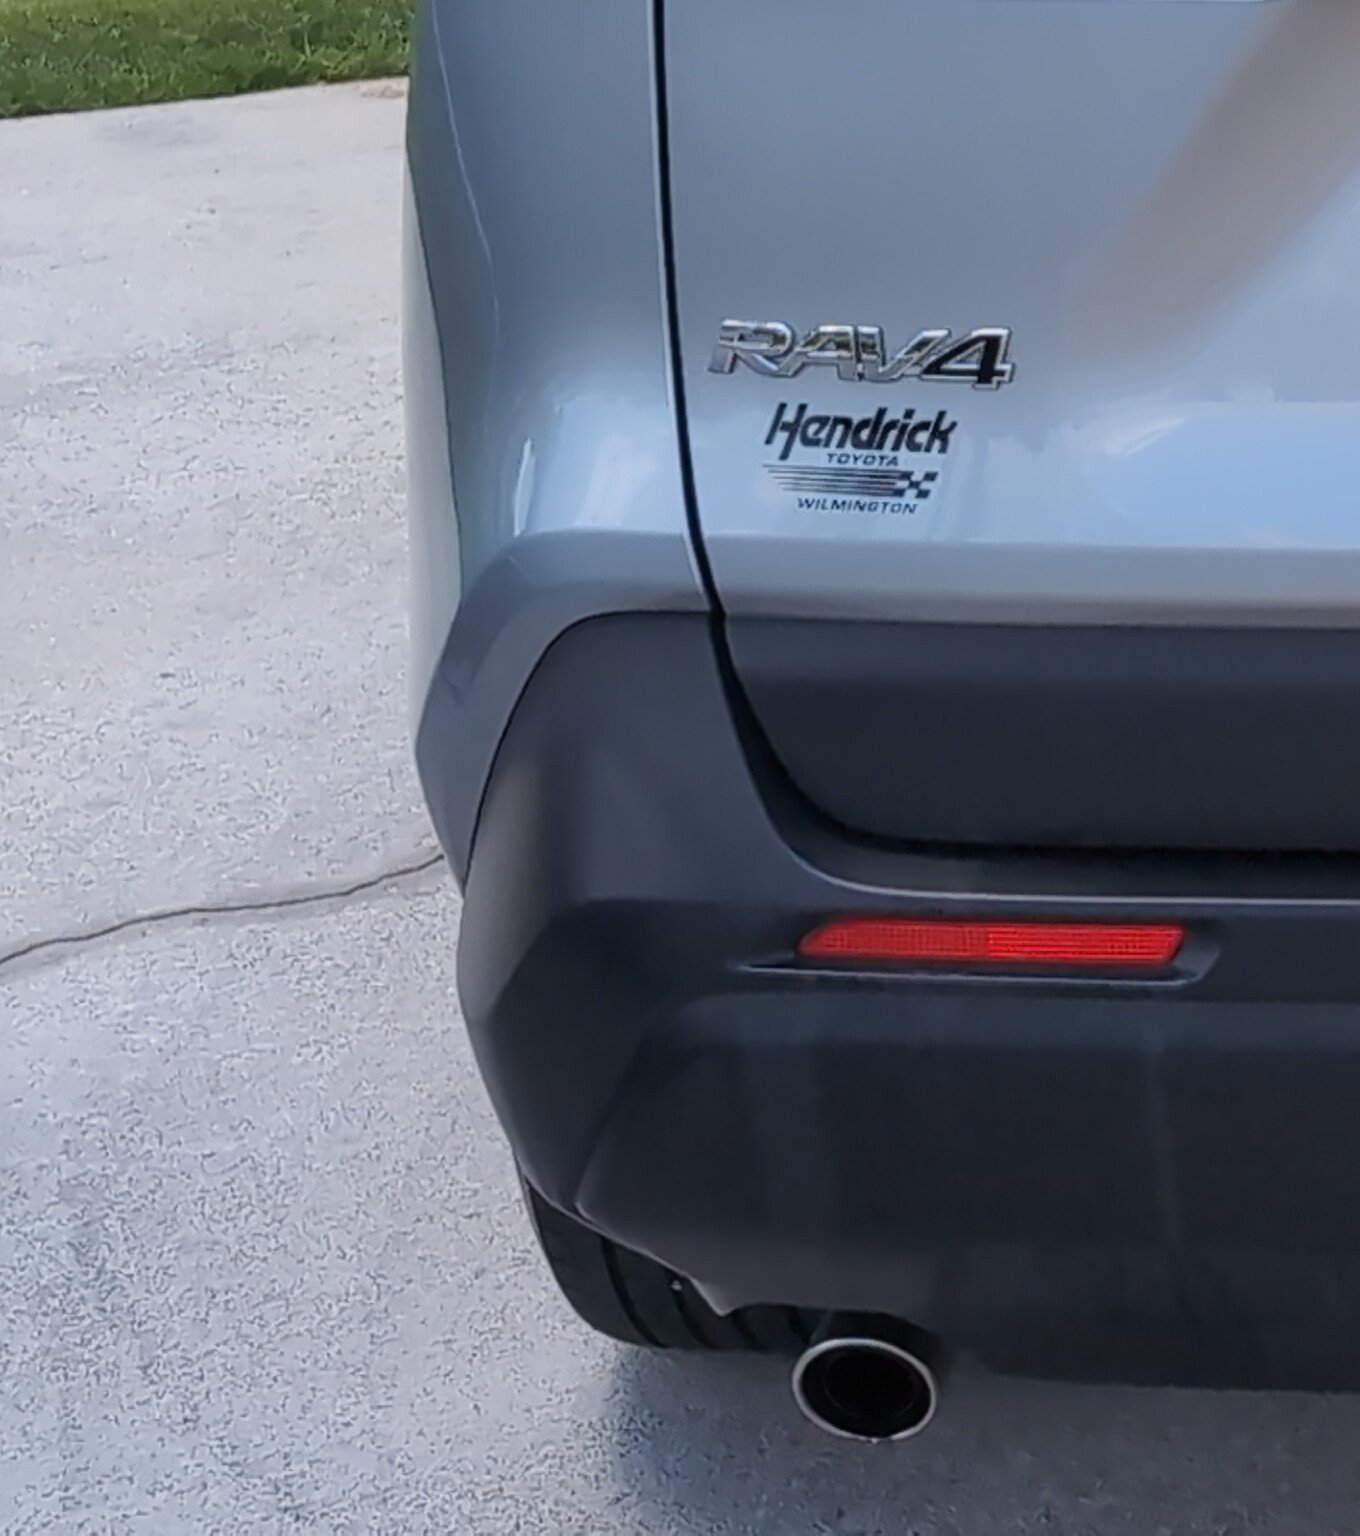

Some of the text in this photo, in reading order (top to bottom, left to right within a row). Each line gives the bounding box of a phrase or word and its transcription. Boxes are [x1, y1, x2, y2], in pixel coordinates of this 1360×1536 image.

[708, 319, 1016, 390] RAV4
[765, 402, 957, 461] Hendrick
[826, 453, 899, 467] TOYOTA
[798, 498, 918, 514] WILMINGTON
